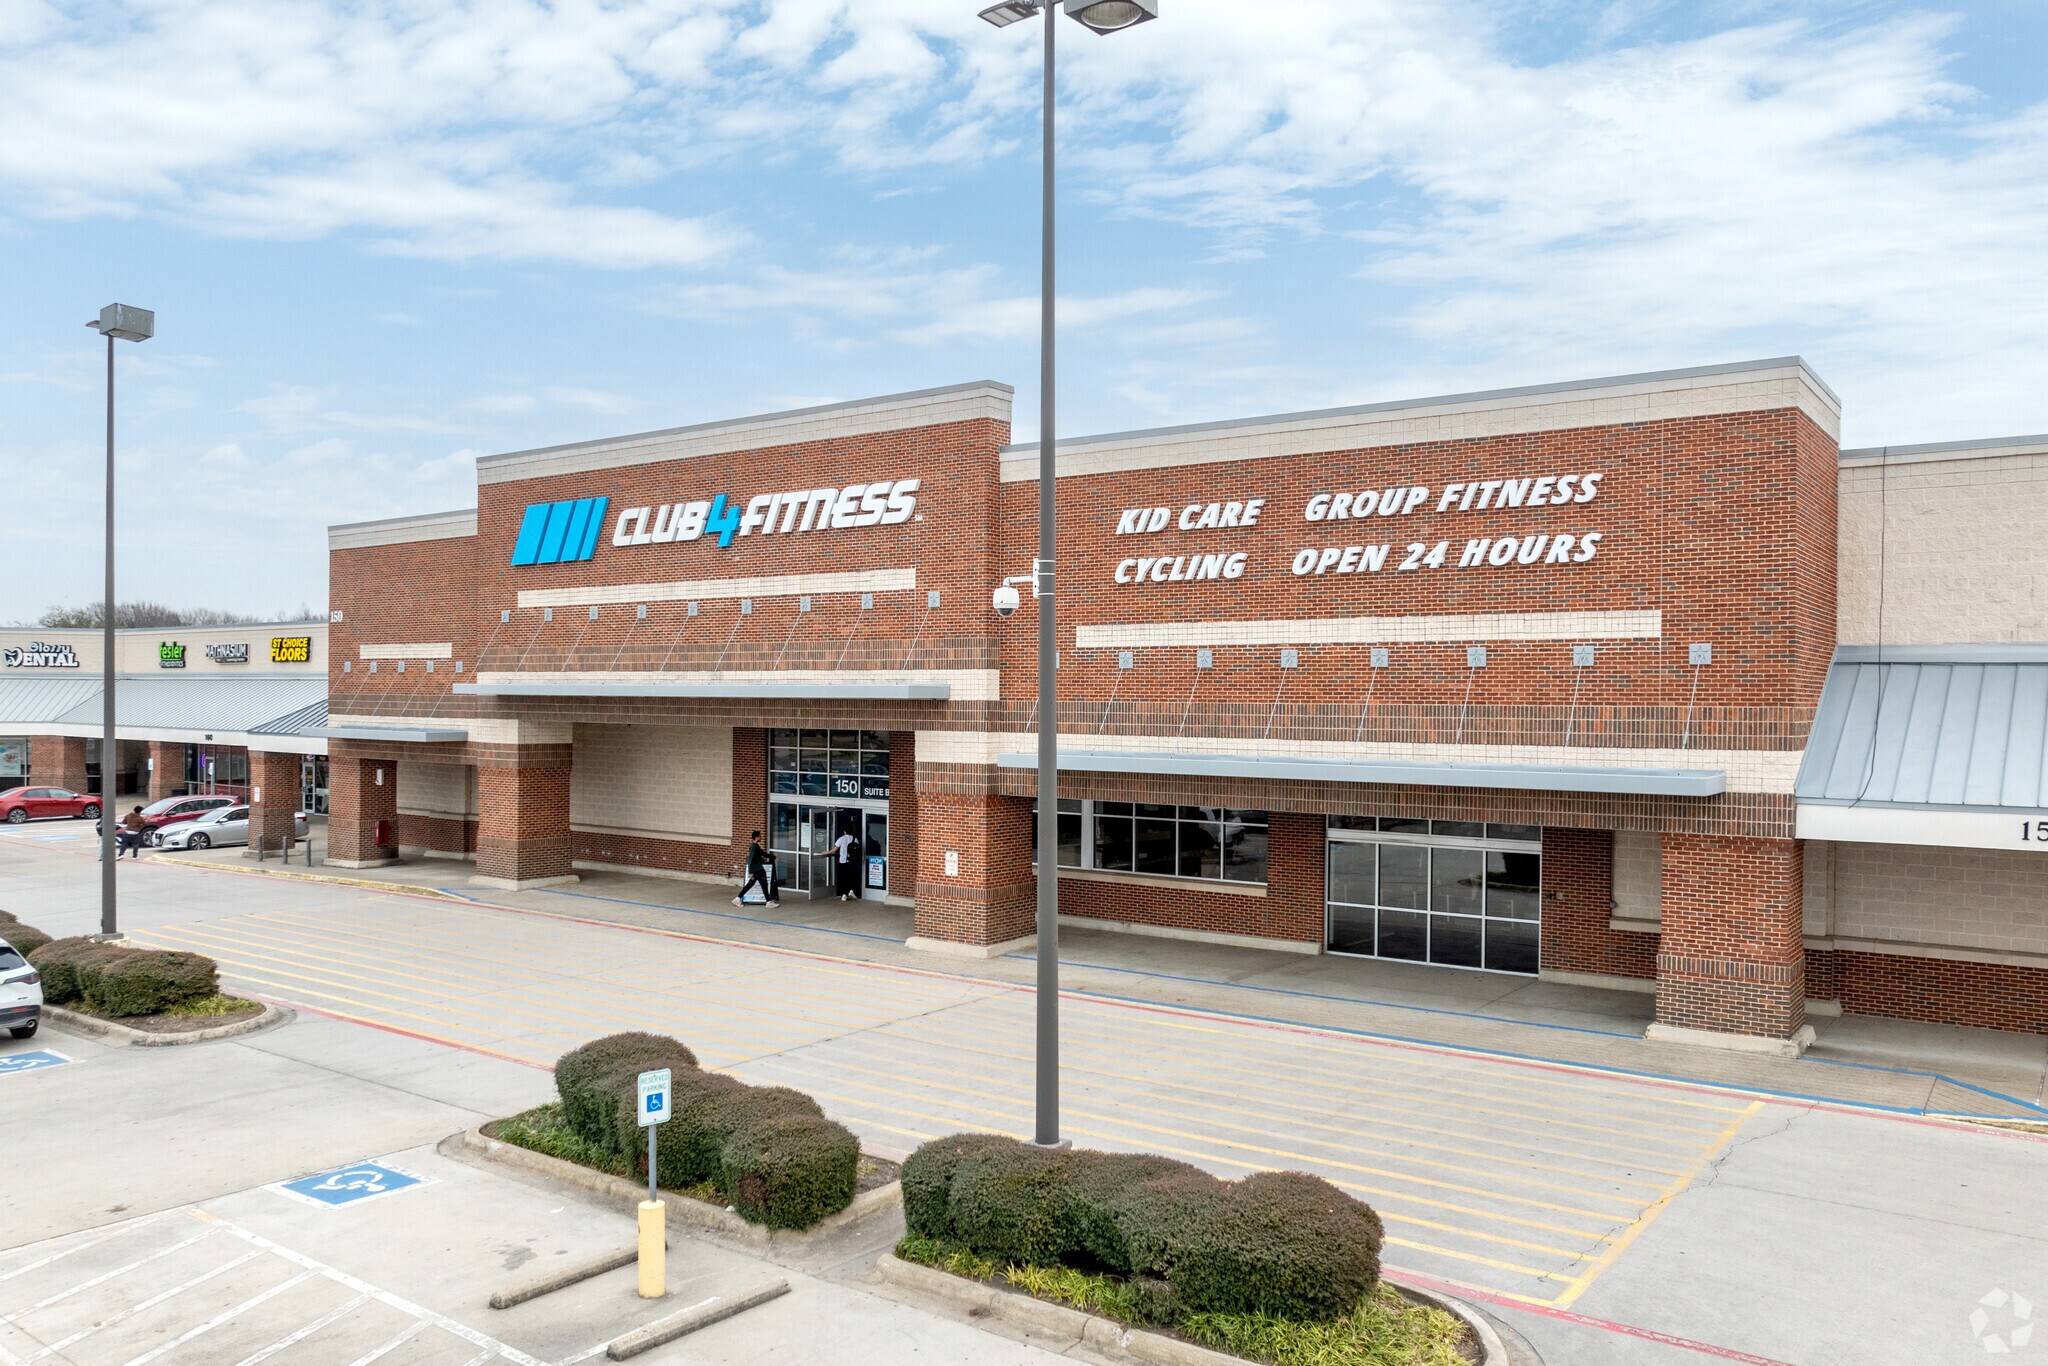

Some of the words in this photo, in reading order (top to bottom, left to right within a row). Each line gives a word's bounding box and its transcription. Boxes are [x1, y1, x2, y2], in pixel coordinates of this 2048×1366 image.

[1304, 486, 1431, 522] GROUP
[1435, 472, 1605, 514] FITNESS
[1115, 506, 1172, 535] KID
[1178, 498, 1266, 531] CARE
[1291, 544, 1391, 576] OPEN
[1397, 540, 1451, 571] 24
[1456, 532, 1605, 568] HOURS
[1114, 552, 1249, 584] CYCLING
[330, 610, 343, 622] 150
[282, 638, 309, 648] CHOICE
[270, 648, 308, 661] FLOORS
[836, 779, 858, 794] 150
[864, 788, 884, 796] SUITE
